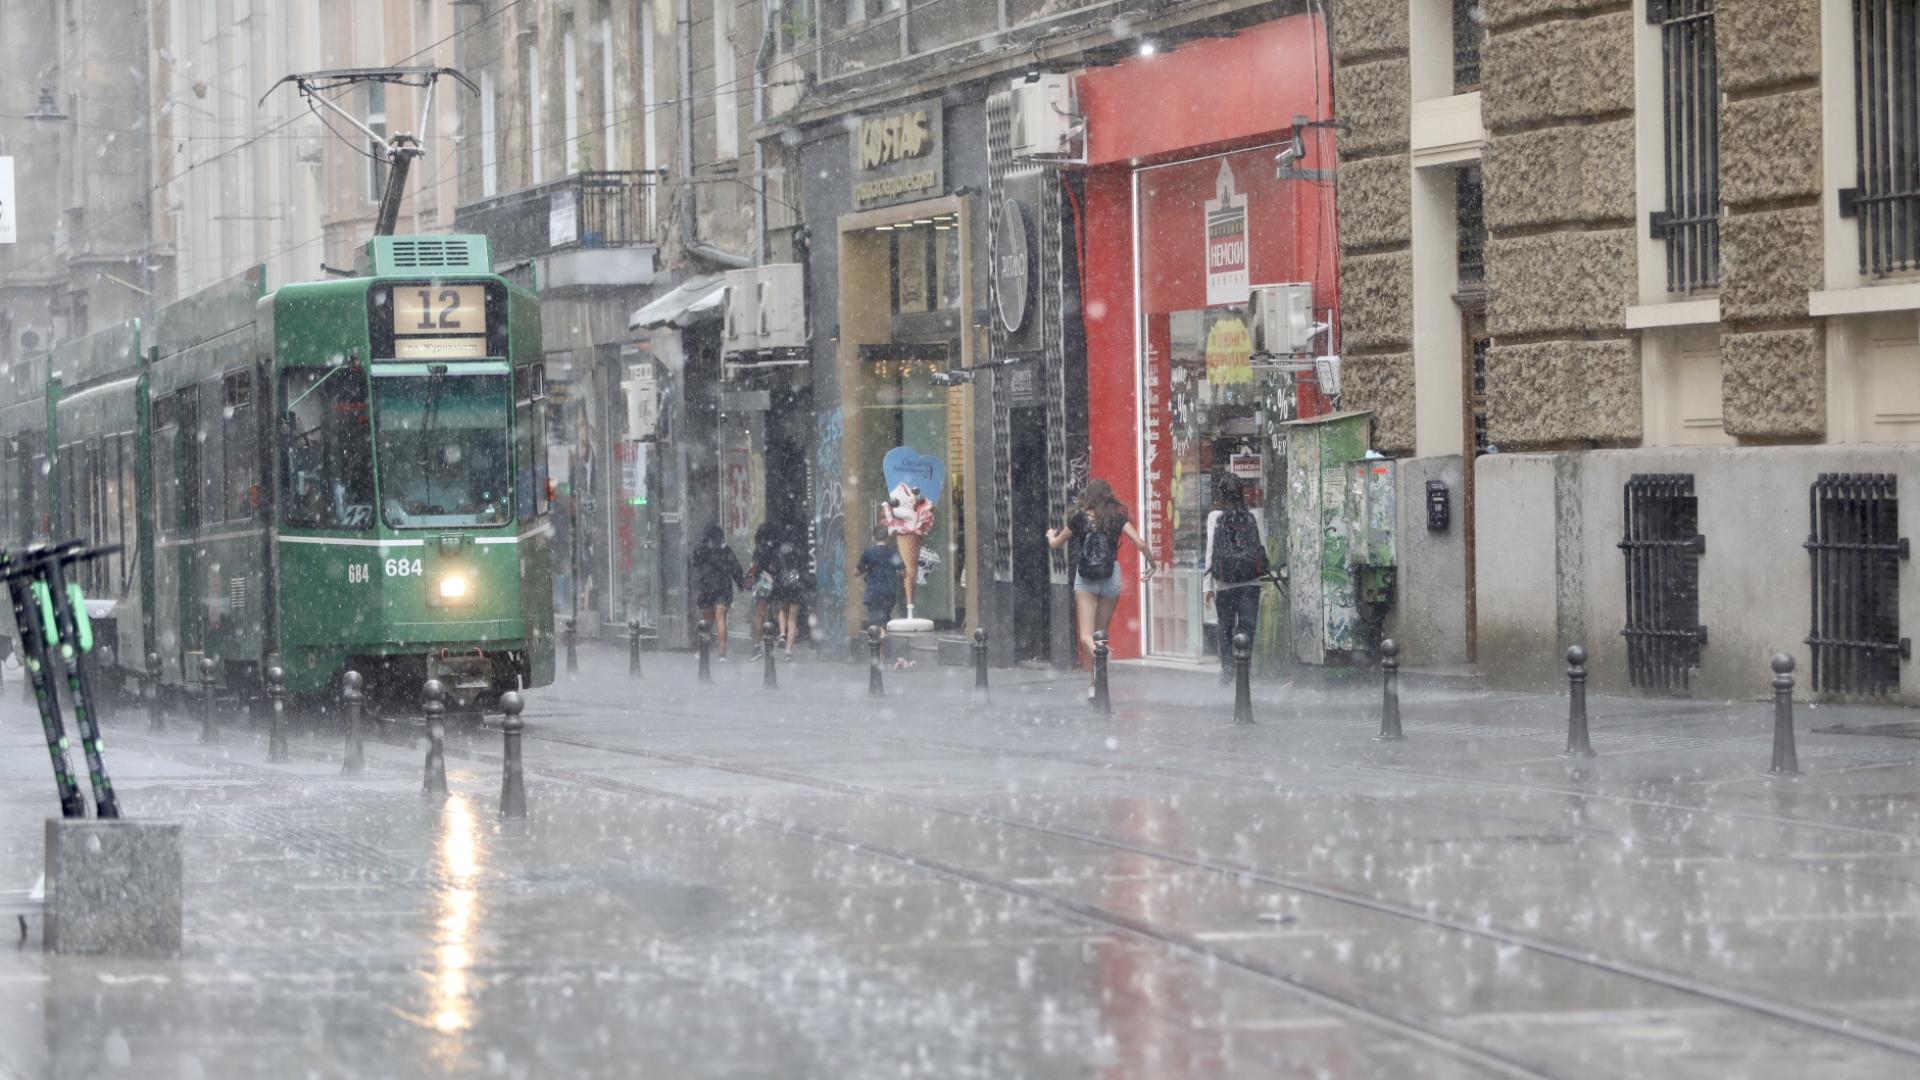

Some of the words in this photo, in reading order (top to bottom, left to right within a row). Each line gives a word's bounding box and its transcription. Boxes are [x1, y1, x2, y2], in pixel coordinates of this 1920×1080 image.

[1210, 240, 1244, 268] НЕМСКИ
[417, 289, 461, 330] 12
[348, 564, 369, 584] 684
[385, 558, 423, 577] 684
